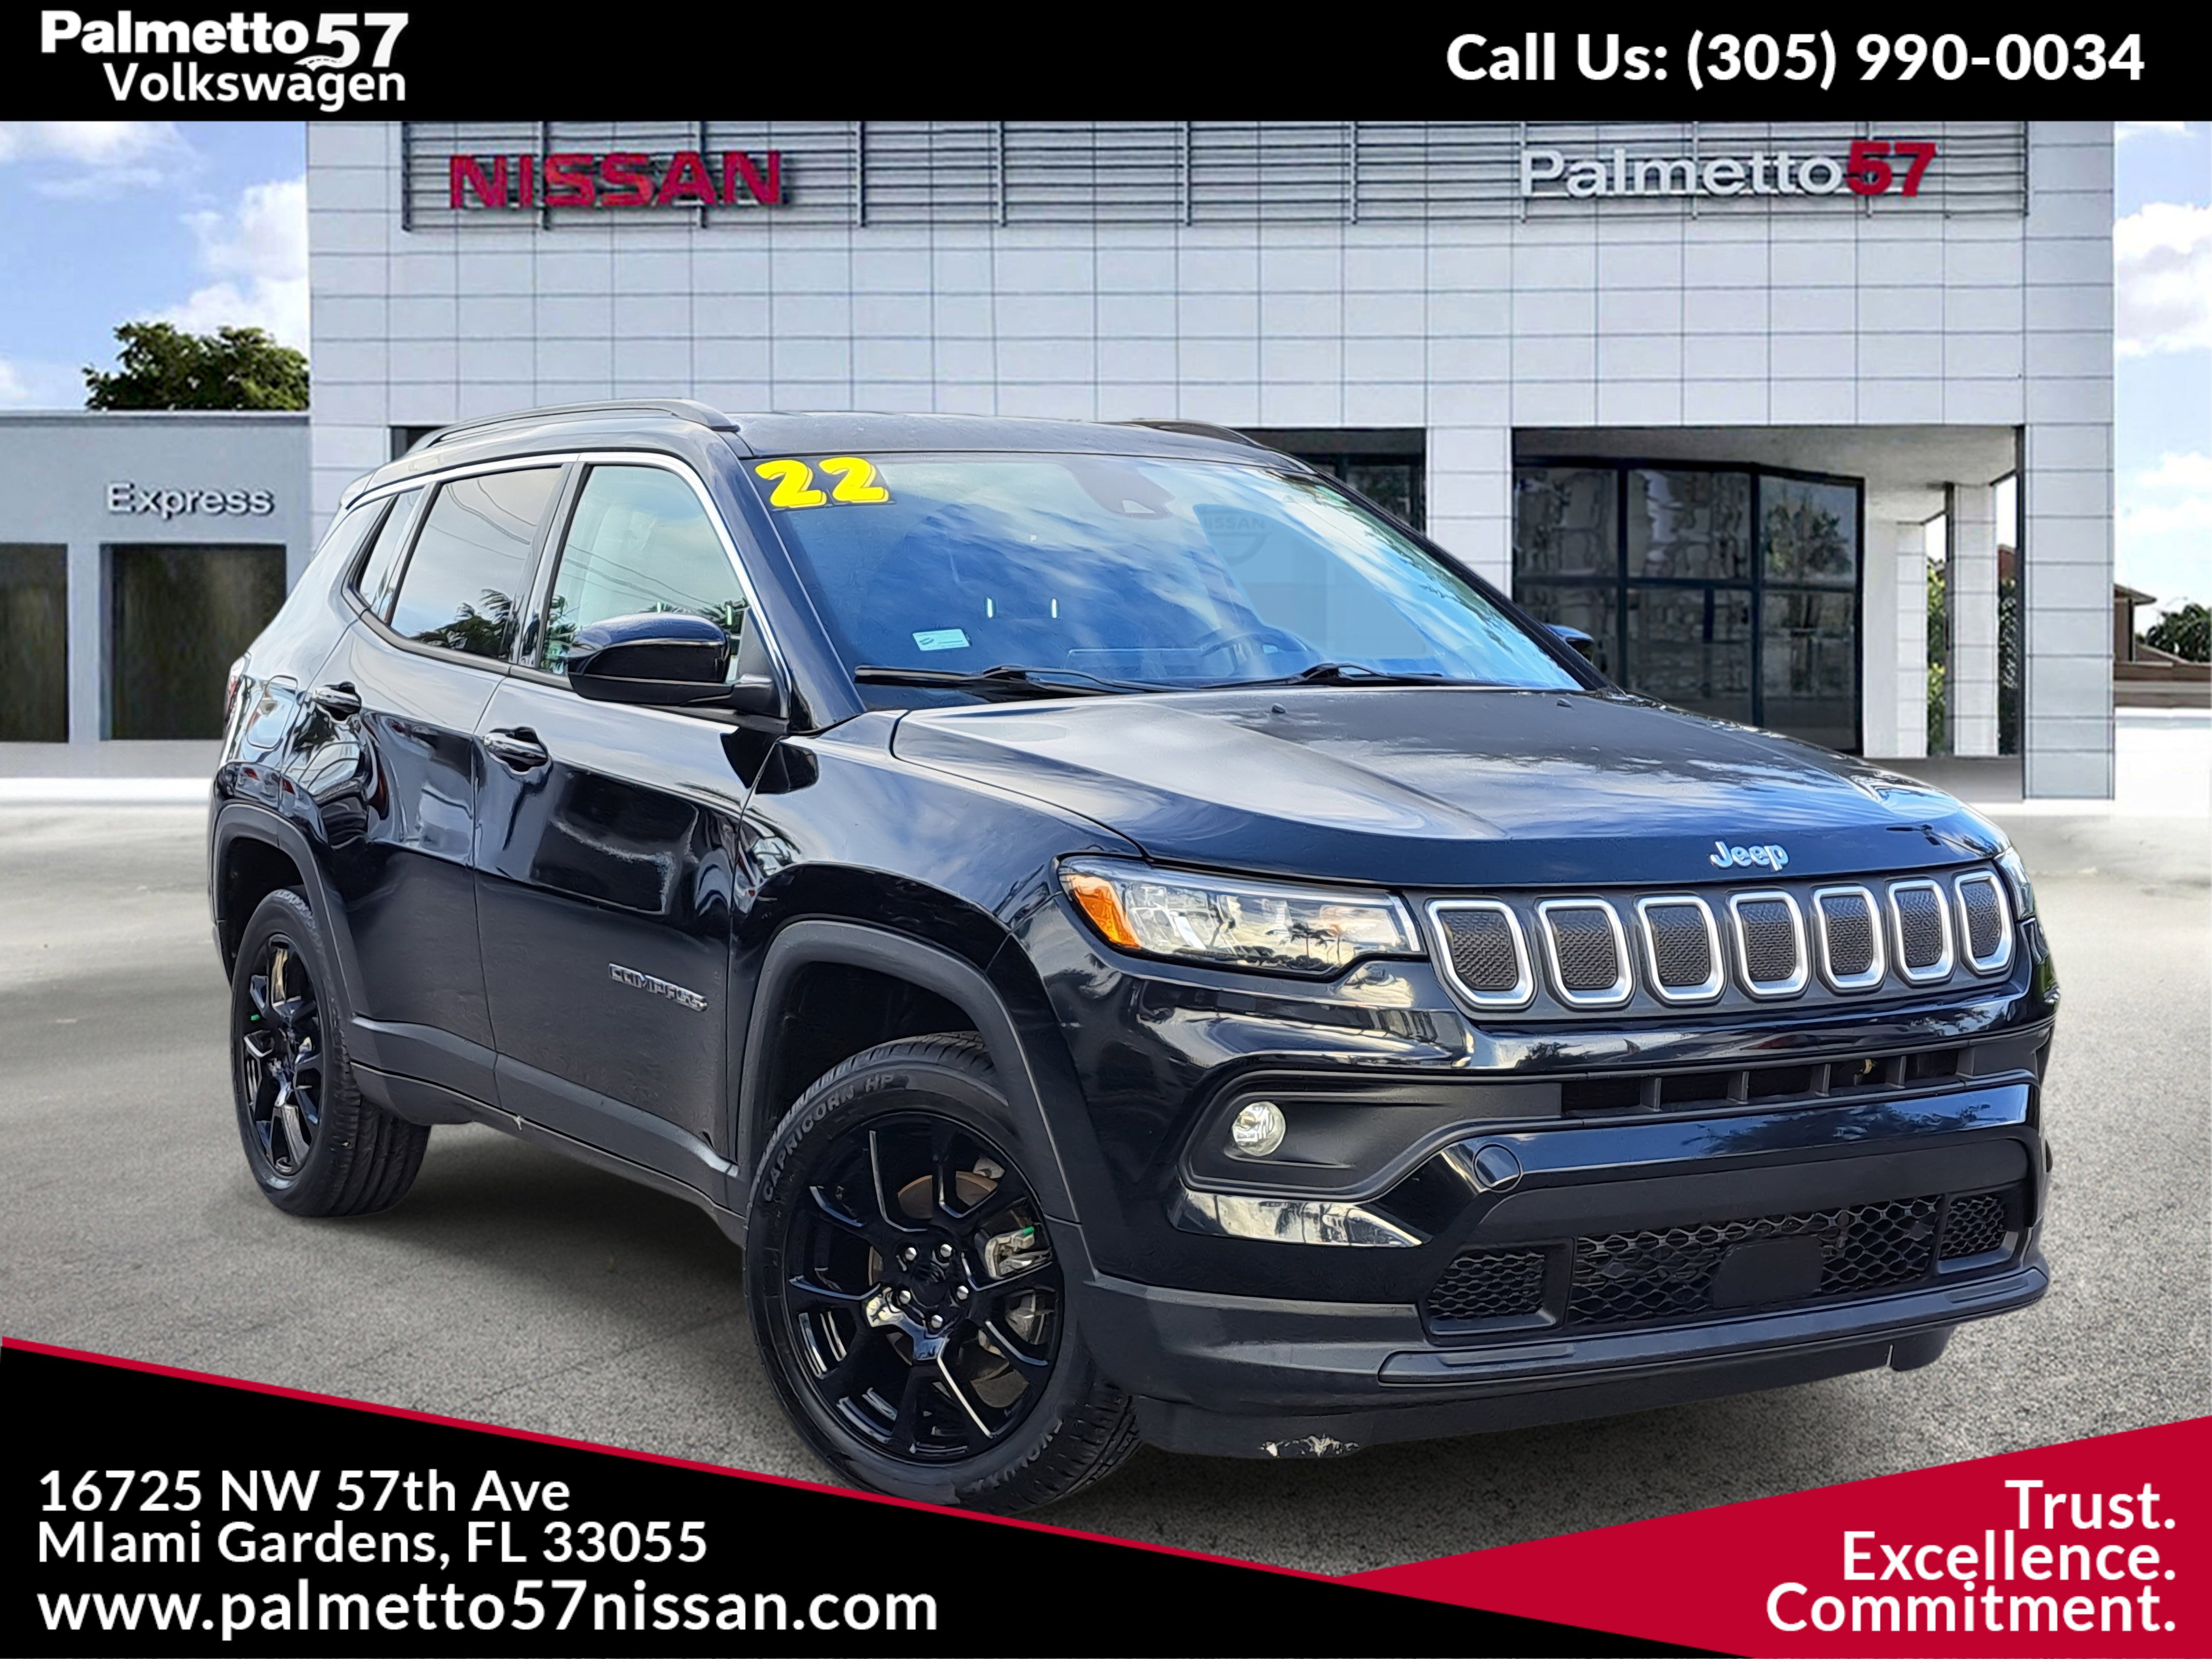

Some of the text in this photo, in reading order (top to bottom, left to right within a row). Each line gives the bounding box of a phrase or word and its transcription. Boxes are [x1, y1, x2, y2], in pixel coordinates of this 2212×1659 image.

[450, 151, 781, 209] NISSAN
[107, 482, 275, 520] Express
[755, 456, 889, 508] 22
[1709, 840, 1789, 872] Jeep
[764, 1073, 894, 1202] CAPRICORN HP
